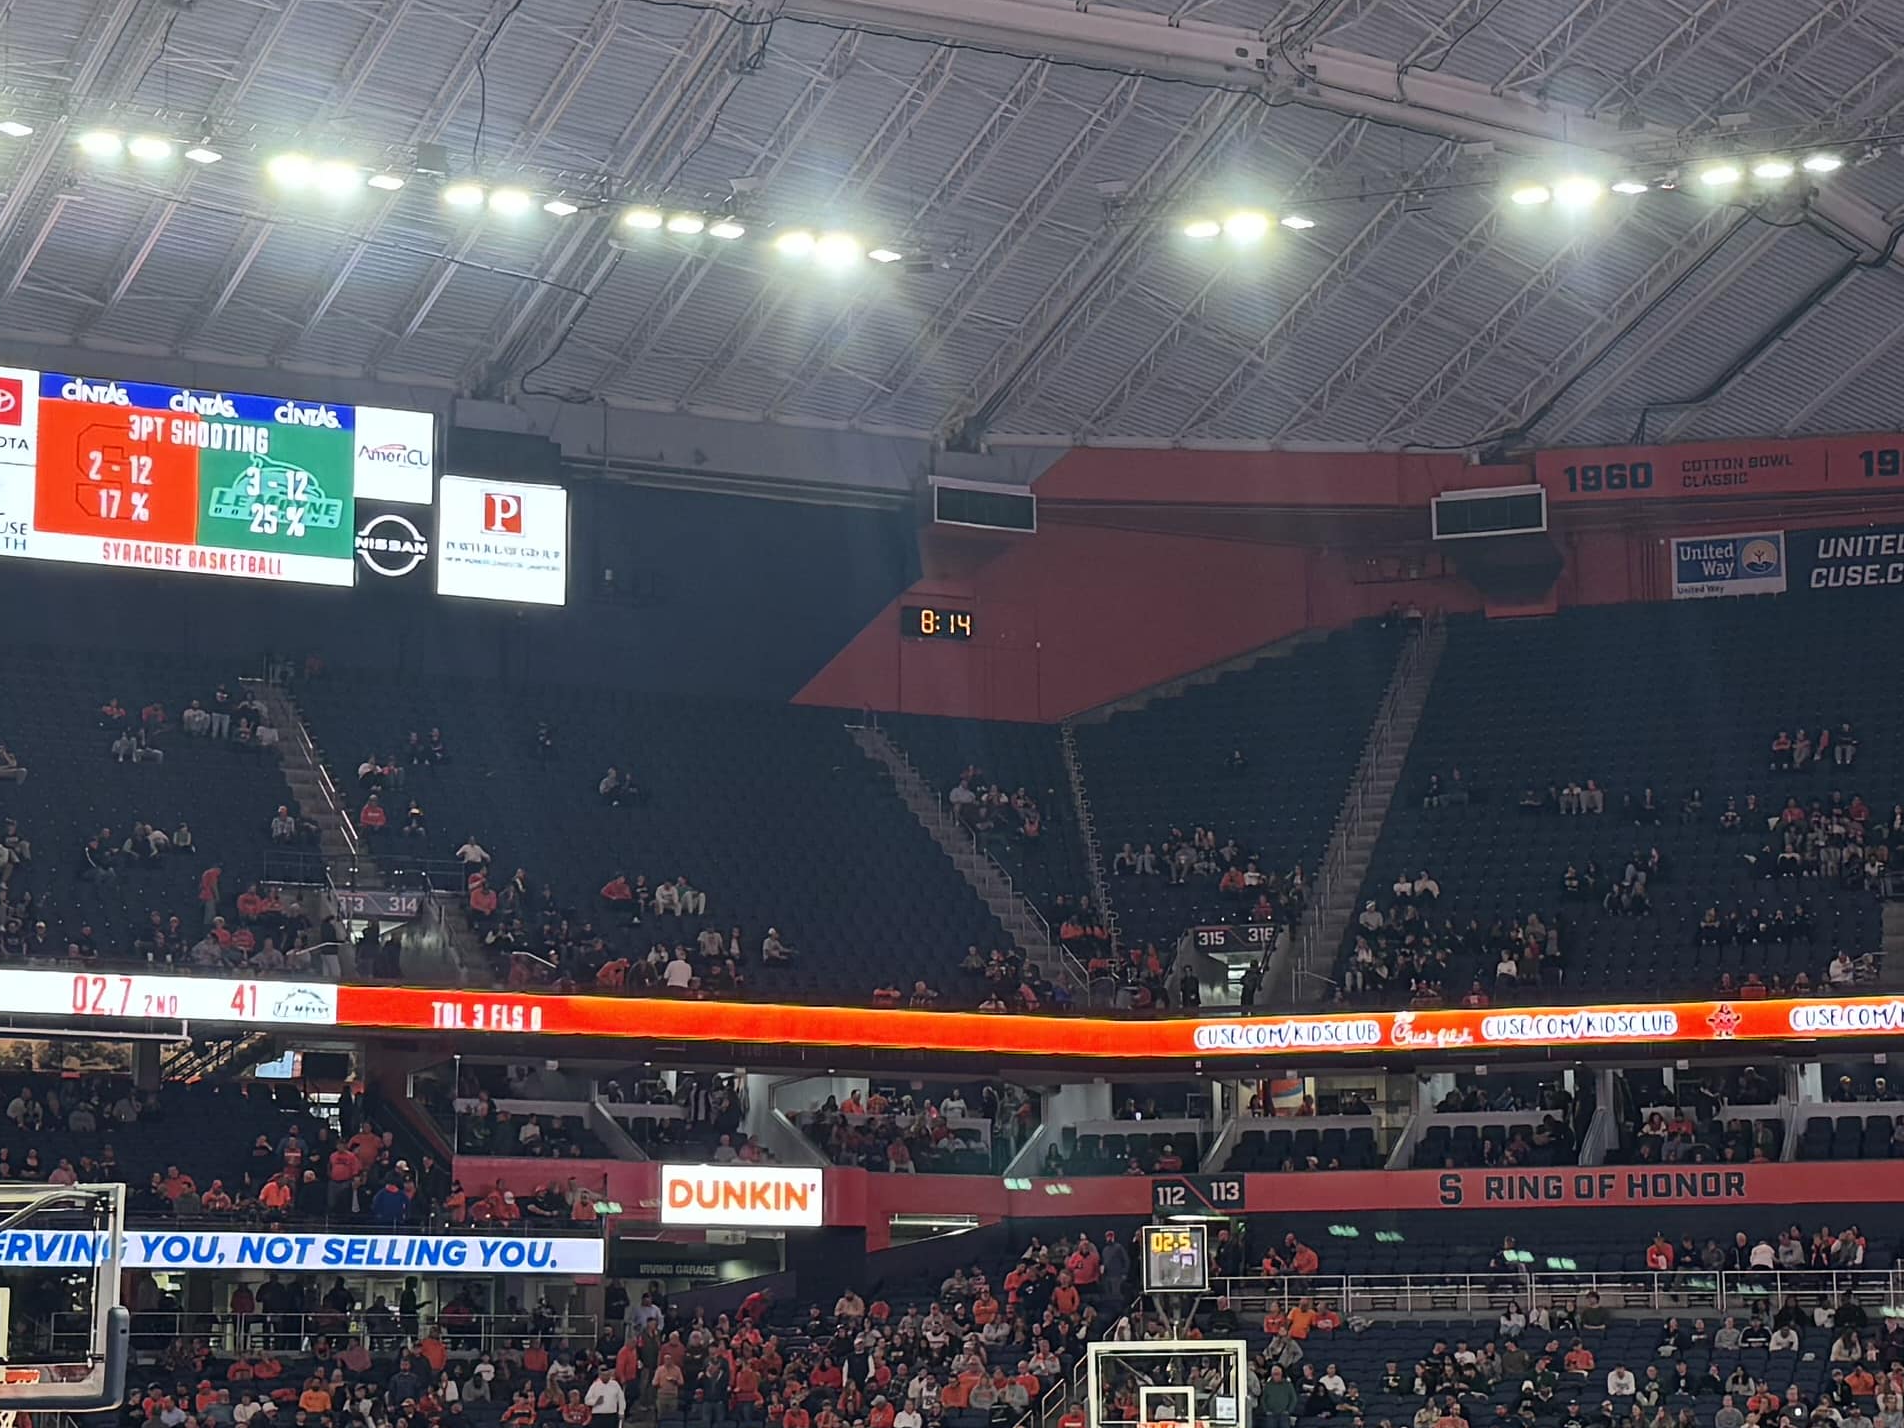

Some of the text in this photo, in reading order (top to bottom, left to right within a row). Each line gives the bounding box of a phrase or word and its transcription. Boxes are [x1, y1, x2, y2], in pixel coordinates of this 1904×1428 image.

[128, 414, 269, 455] 3PT SHOOTING
[1564, 453, 1794, 493] 1960 COTTON BOWL
[1681, 471, 1749, 488] CLASSIC
[98, 491, 149, 523] 17 %
[250, 503, 279, 534] 25
[285, 504, 305, 538] %
[102, 542, 284, 577] SYRACUSE BASKETBALL
[355, 535, 429, 555] NISSAN
[1680, 543, 1734, 561] United
[1701, 559, 1735, 578] Way
[919, 608, 972, 636] 8:14
[1198, 929, 1226, 946] 315
[1248, 926, 1276, 943] 316
[72, 976, 132, 1015] 02.7
[144, 994, 178, 1017] 2ND
[230, 984, 257, 1018] 41
[669, 1178, 817, 1211] DUNKIN'
[1156, 1184, 1186, 1206] 112
[1210, 1180, 1240, 1202] 113
[1440, 1172, 1746, 1205] S RING OF HONOR
[142, 1234, 557, 1268] YOU, NOT SELLING YOU.
